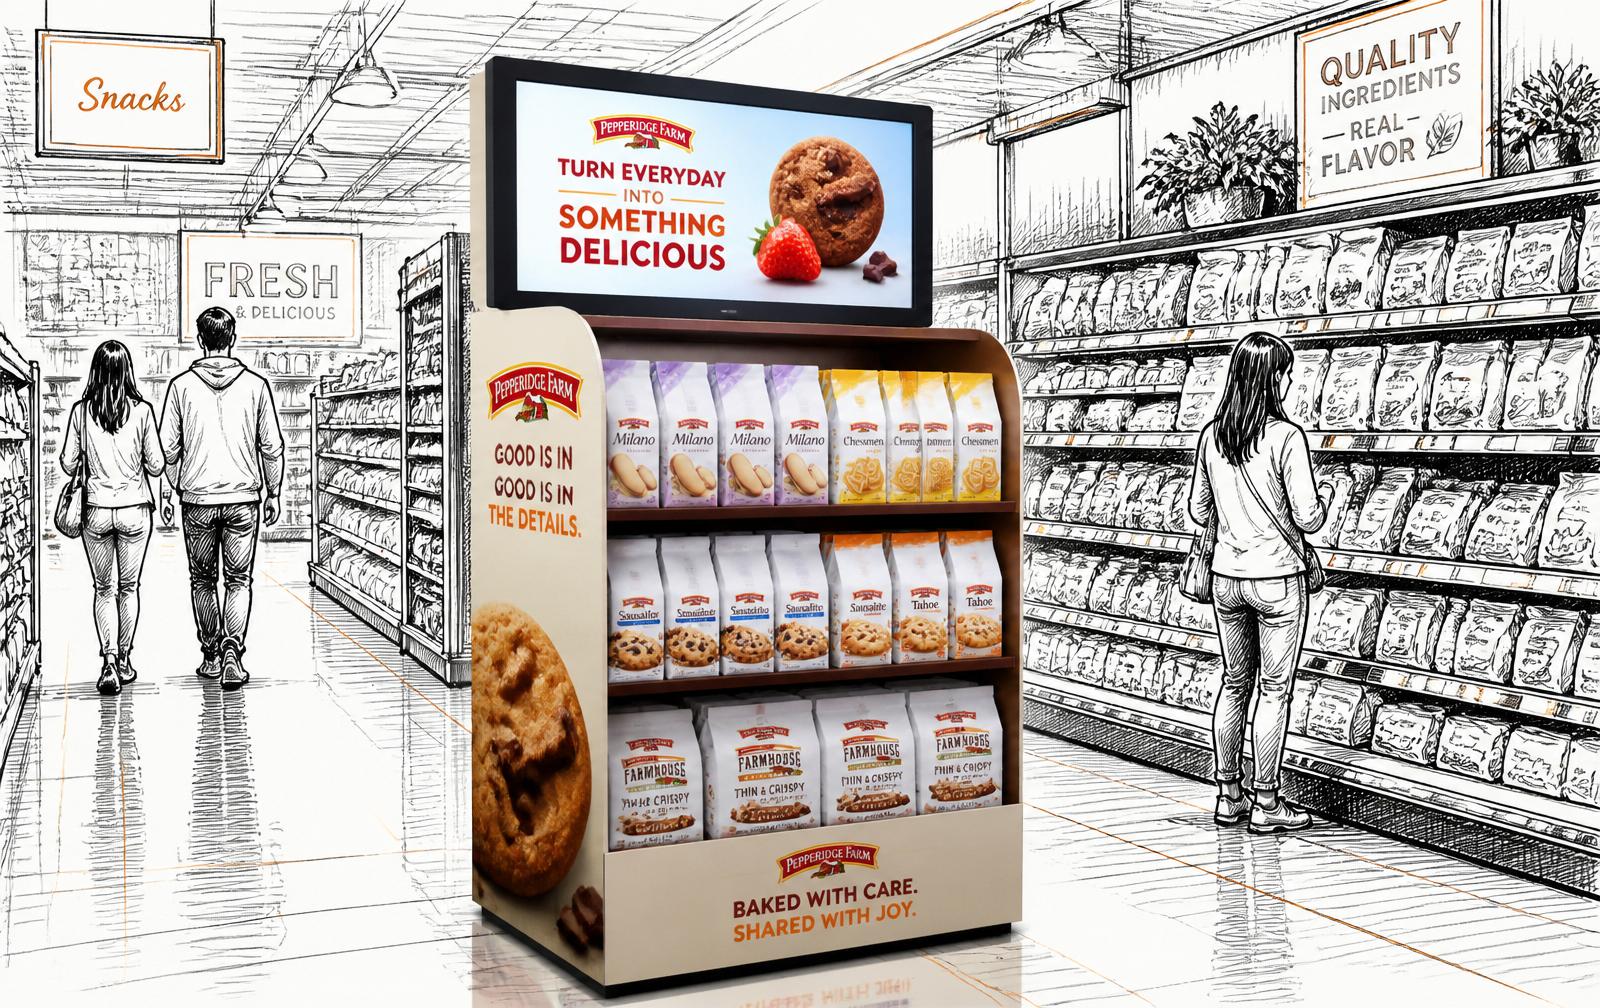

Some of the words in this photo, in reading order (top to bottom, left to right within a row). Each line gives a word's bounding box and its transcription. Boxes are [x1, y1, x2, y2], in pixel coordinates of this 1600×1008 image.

[1320, 21, 1461, 87] QUALITY
[77, 76, 187, 112] Snacks
[1320, 62, 1461, 115] INGREDIENTS
[600, 120, 658, 135] PEPPERIDGE
[660, 122, 687, 143] FARM
[1350, 113, 1404, 141] REAL
[557, 157, 614, 179] TURN
[621, 163, 726, 188] EVERYDAY
[1321, 137, 1416, 178] FLAVOR
[623, 188, 664, 205] INTO
[558, 203, 725, 237] SOMETHING
[560, 236, 726, 272] DELICIOUS
[204, 261, 339, 299] FRESH
[235, 305, 247, 319] &
[251, 305, 336, 320] DELICIOUS
[494, 373, 546, 403] PEPPERIDGE
[547, 371, 574, 402] FARM
[612, 432, 656, 446] Milano
[672, 432, 714, 446] Milano
[730, 432, 771, 446] Milano
[785, 433, 825, 446] Milano
[494, 443, 536, 467] GOOD
[540, 445, 553, 469] IS
[557, 445, 573, 470] IN
[494, 476, 536, 501] GOOD
[540, 481, 553, 503] IS
[557, 484, 574, 506] IN
[488, 503, 514, 527] THE
[518, 507, 582, 538] DETAILS.
[786, 848, 843, 873] PEPPERIDGE
[845, 846, 871, 861] FARM
[733, 893, 801, 918] BAKED
[806, 886, 857, 908] WITH
[863, 878, 918, 900] CARE.
[733, 914, 815, 943] SHARED
[821, 907, 870, 930] WITH
[876, 900, 916, 922] JOY.
